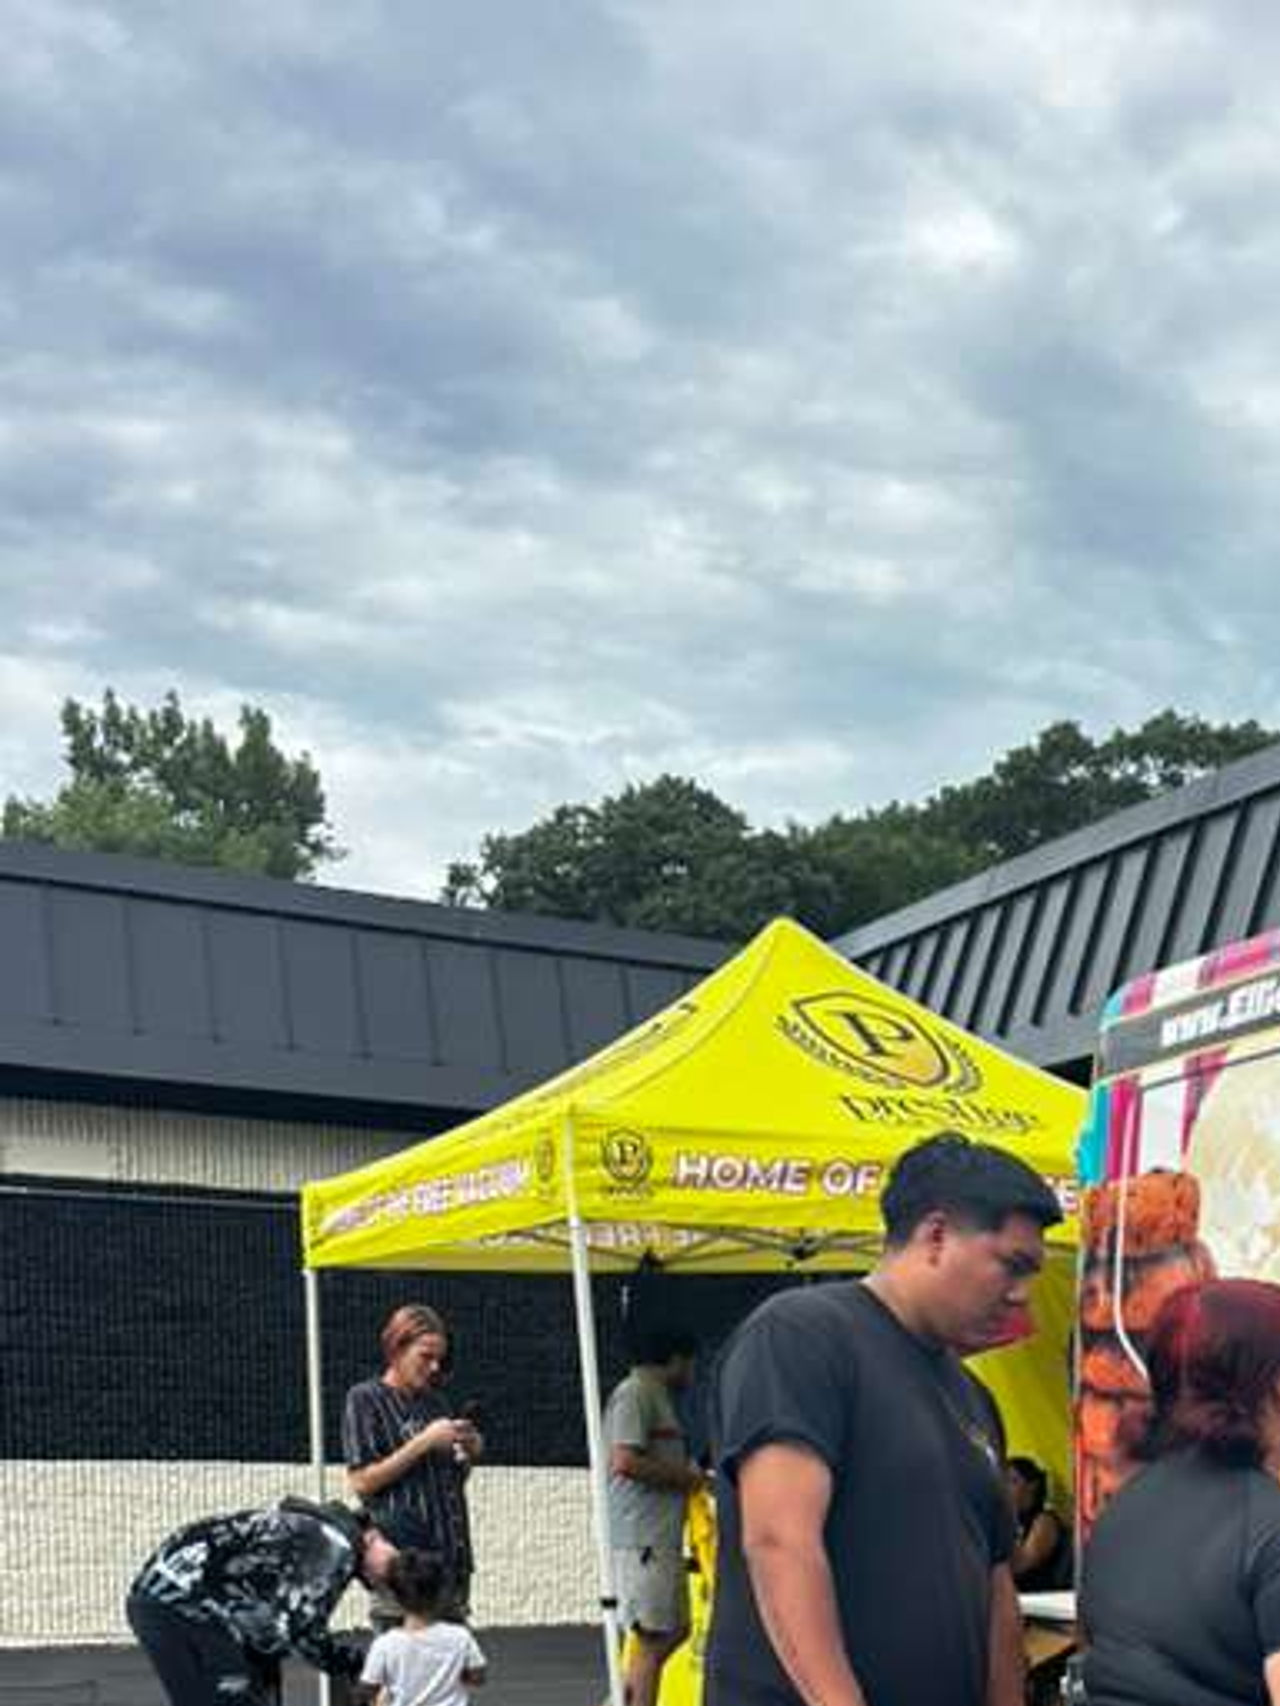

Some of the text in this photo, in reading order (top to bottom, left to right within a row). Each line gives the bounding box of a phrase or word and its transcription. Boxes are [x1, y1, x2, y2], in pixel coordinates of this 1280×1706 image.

[825, 1009, 915, 1058] P
[676, 1151, 809, 1192] HOME
[821, 1157, 882, 1195] OF
